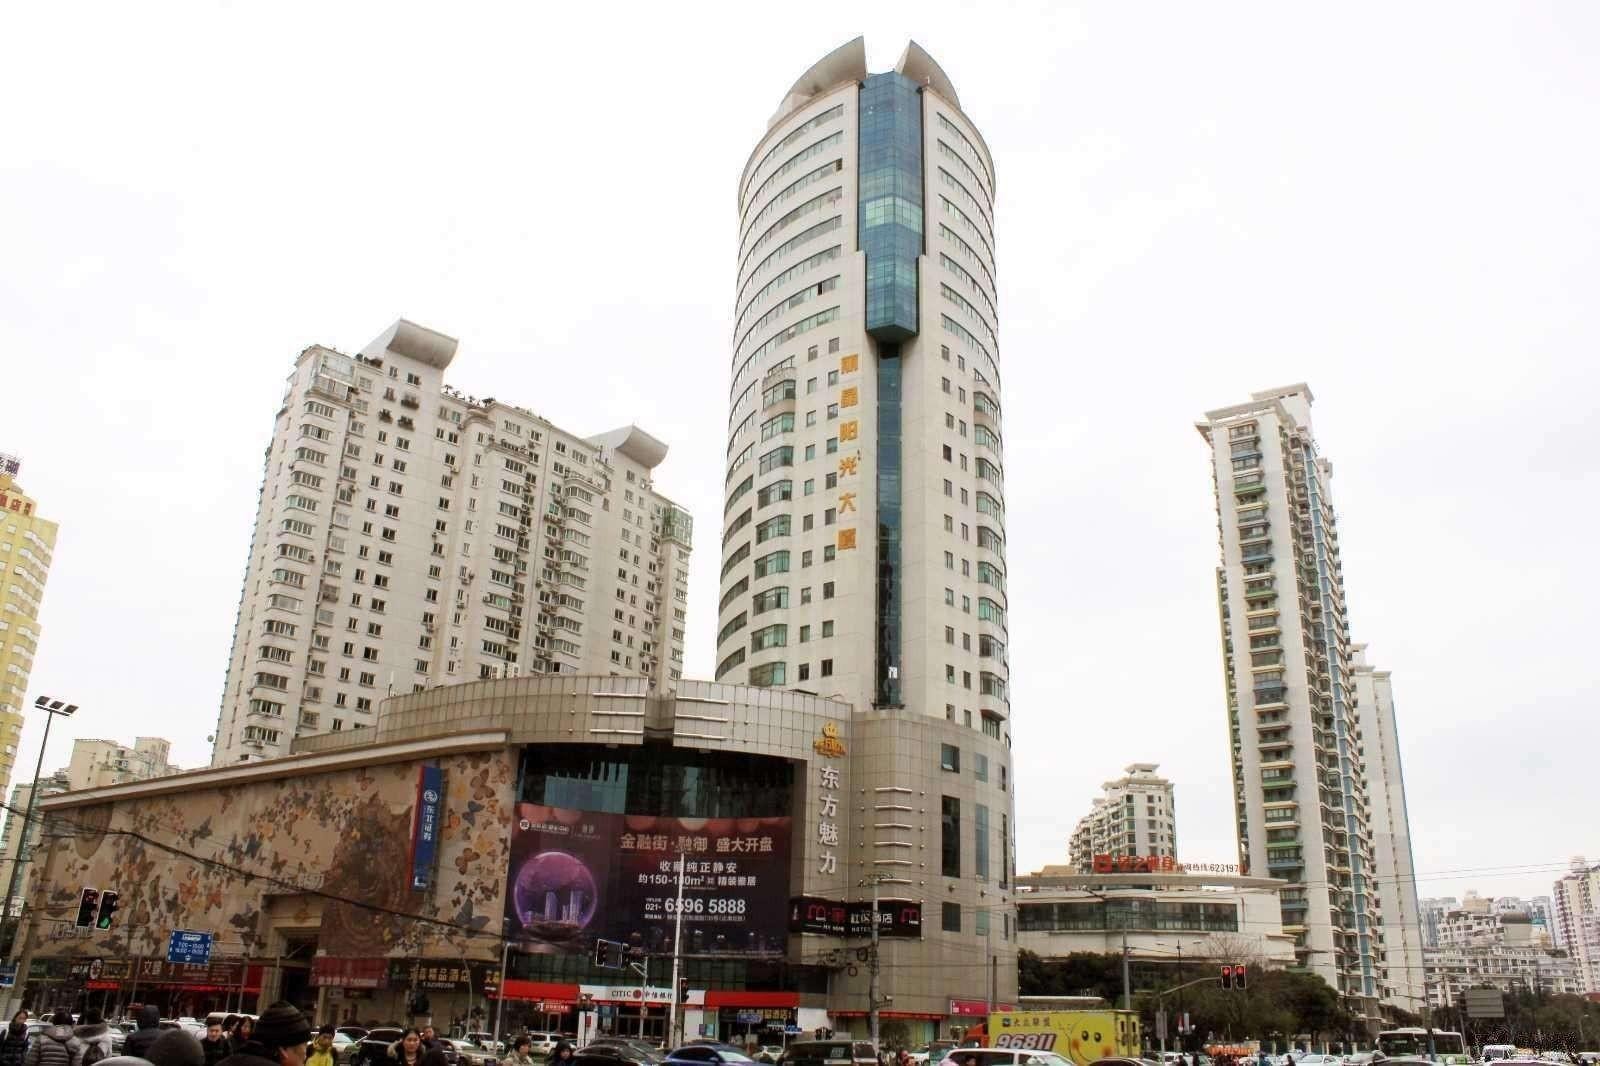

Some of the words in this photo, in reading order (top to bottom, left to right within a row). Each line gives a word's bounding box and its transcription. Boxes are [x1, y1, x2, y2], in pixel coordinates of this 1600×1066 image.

[819, 765, 840, 874] 东方魅力
[716, 836, 774, 853] 盛大开盘
[708, 898, 746, 914] 5888
[611, 990, 632, 998] CITIC
